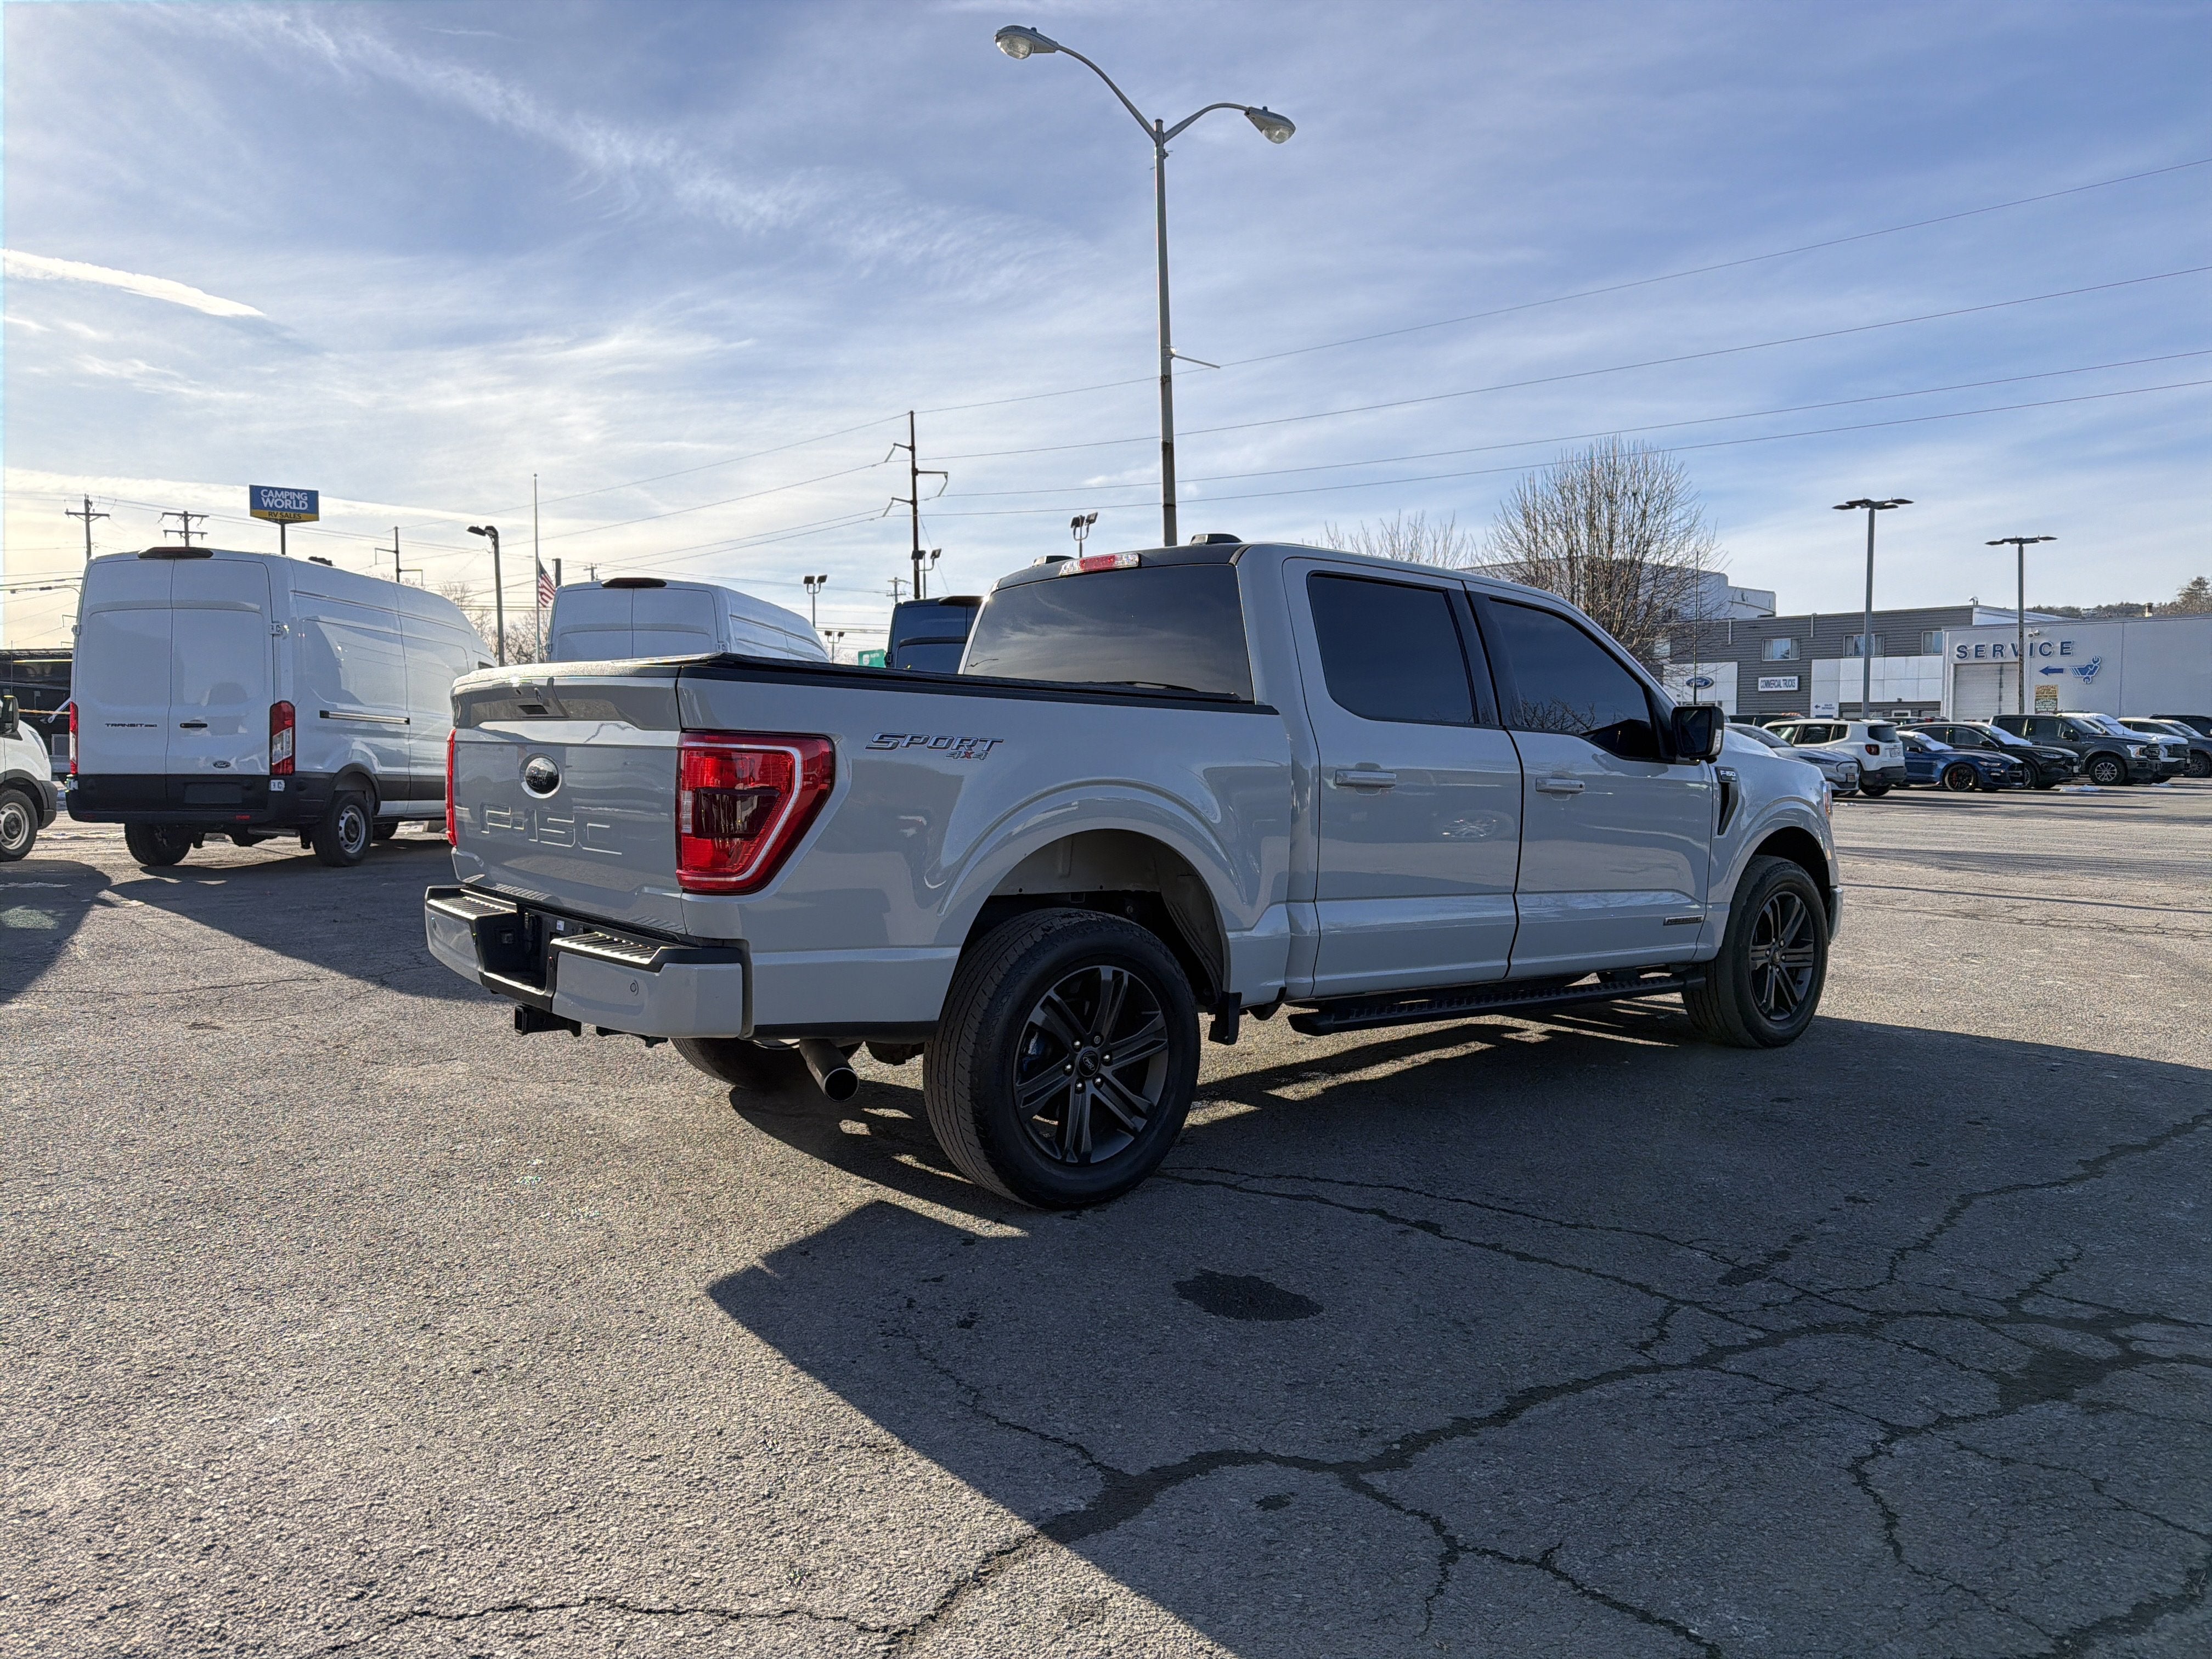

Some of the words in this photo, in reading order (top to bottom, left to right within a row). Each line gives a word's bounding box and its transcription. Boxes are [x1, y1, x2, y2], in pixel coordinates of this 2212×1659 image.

[261, 489, 308, 500] CAMPING
[261, 497, 308, 510] WORLD
[1955, 641, 2073, 659] SERVICE
[1760, 679, 1782, 689] COMMERCIAL
[1782, 679, 1796, 688] TRUCKS
[865, 732, 1005, 751] SPORT
